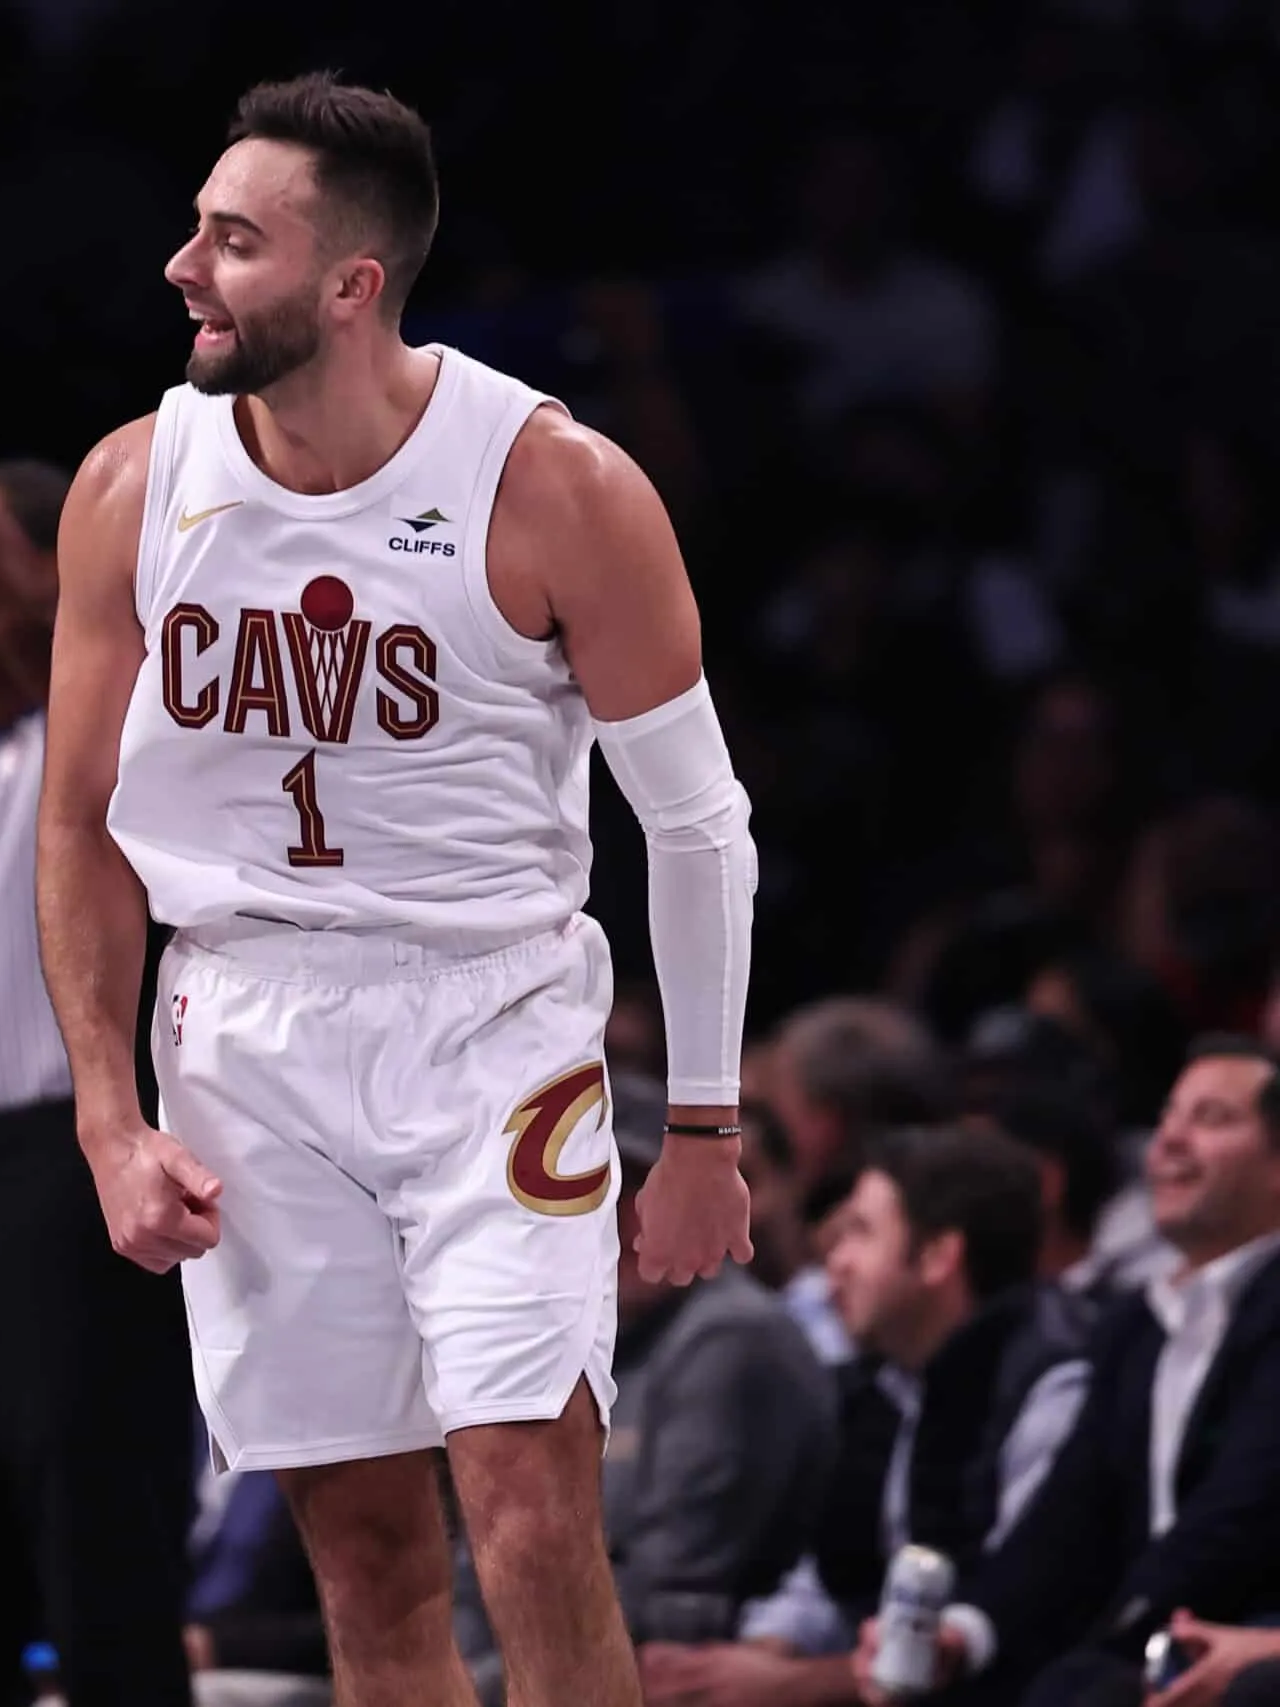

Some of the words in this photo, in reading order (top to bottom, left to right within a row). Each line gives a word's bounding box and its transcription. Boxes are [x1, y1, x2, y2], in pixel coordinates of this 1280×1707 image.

[388, 536, 456, 557] CLIFFS
[161, 602, 440, 744] CAVS
[282, 747, 344, 867] 1
